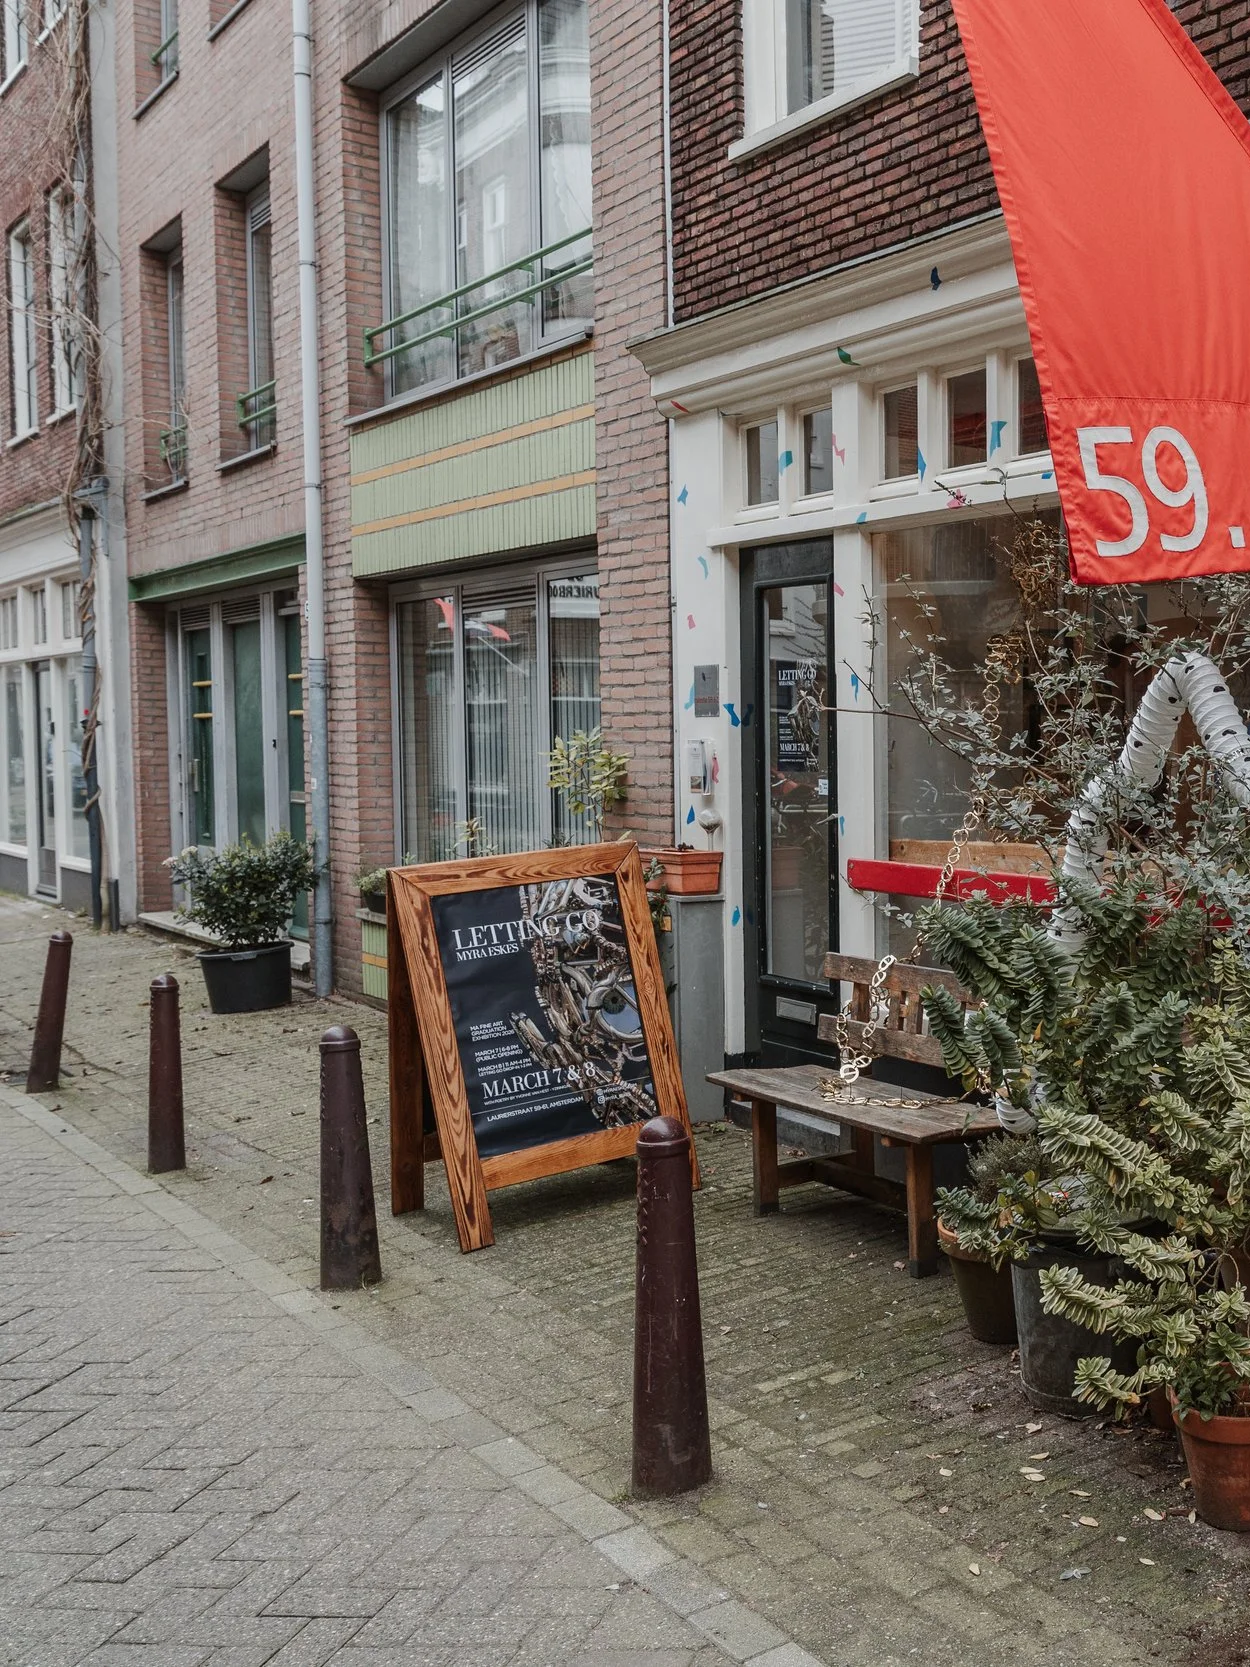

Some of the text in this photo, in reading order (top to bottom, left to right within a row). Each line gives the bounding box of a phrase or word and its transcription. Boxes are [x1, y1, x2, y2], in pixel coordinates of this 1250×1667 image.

[779, 669, 807, 681] LETTING
[780, 743, 797, 751] MARCH
[452, 909, 601, 950] LETTING GO
[456, 943, 520, 962] MYRA ESKES
[471, 1025, 507, 1036] GRADUATION
[472, 1032, 502, 1042] EXHIBITION
[475, 1049, 495, 1057] MARCH
[476, 1049, 523, 1063] (PUBLIC OPENING)
[478, 1064, 498, 1072] MARCH
[481, 1061, 596, 1099] MARCH 7 & 8
[487, 1106, 533, 1122] LAURIERSTRAAT
[549, 1096, 584, 1109] AMSTERDAM
